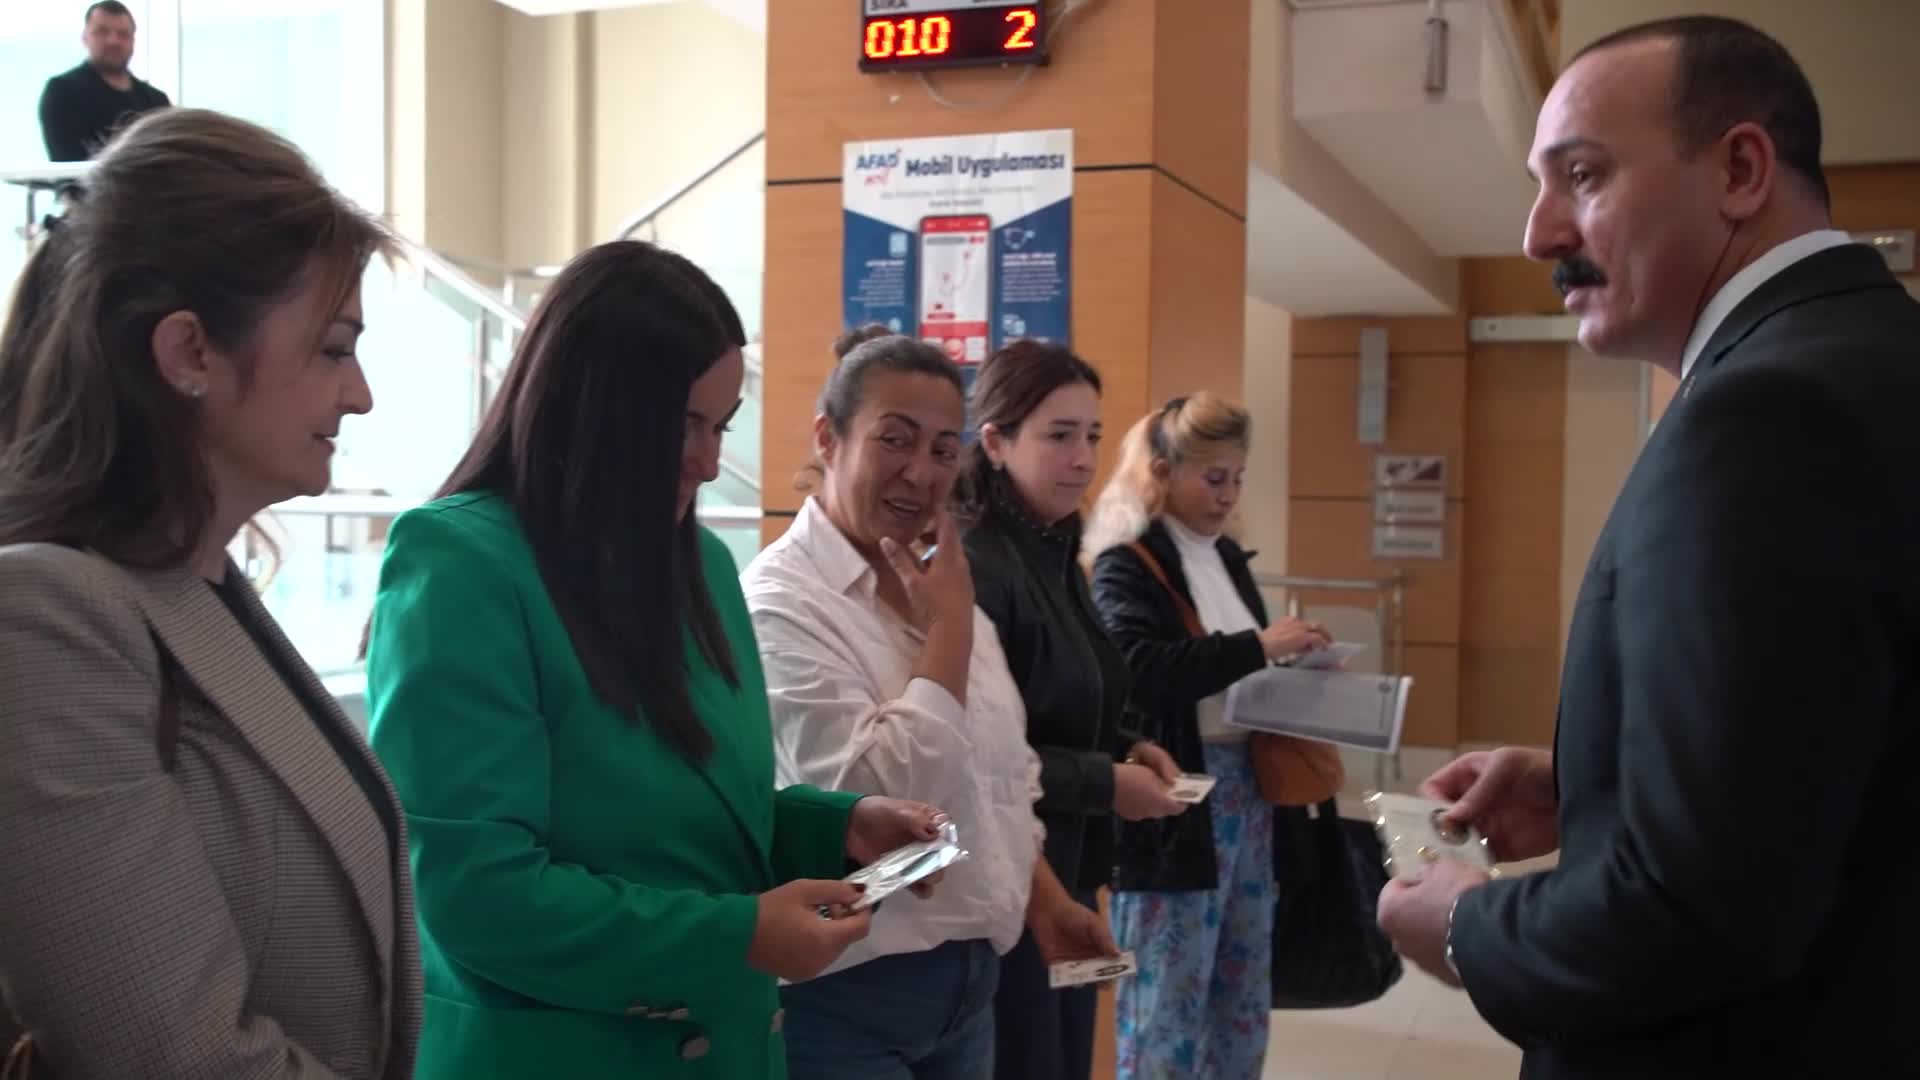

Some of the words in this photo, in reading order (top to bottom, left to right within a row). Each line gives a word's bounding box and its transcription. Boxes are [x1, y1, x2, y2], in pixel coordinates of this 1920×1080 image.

[865, 17, 950, 58] 010
[1004, 10, 1036, 48] 2
[856, 152, 899, 170] AFAD
[905, 155, 953, 177] Mobil
[958, 152, 1064, 177] Uygulaması
